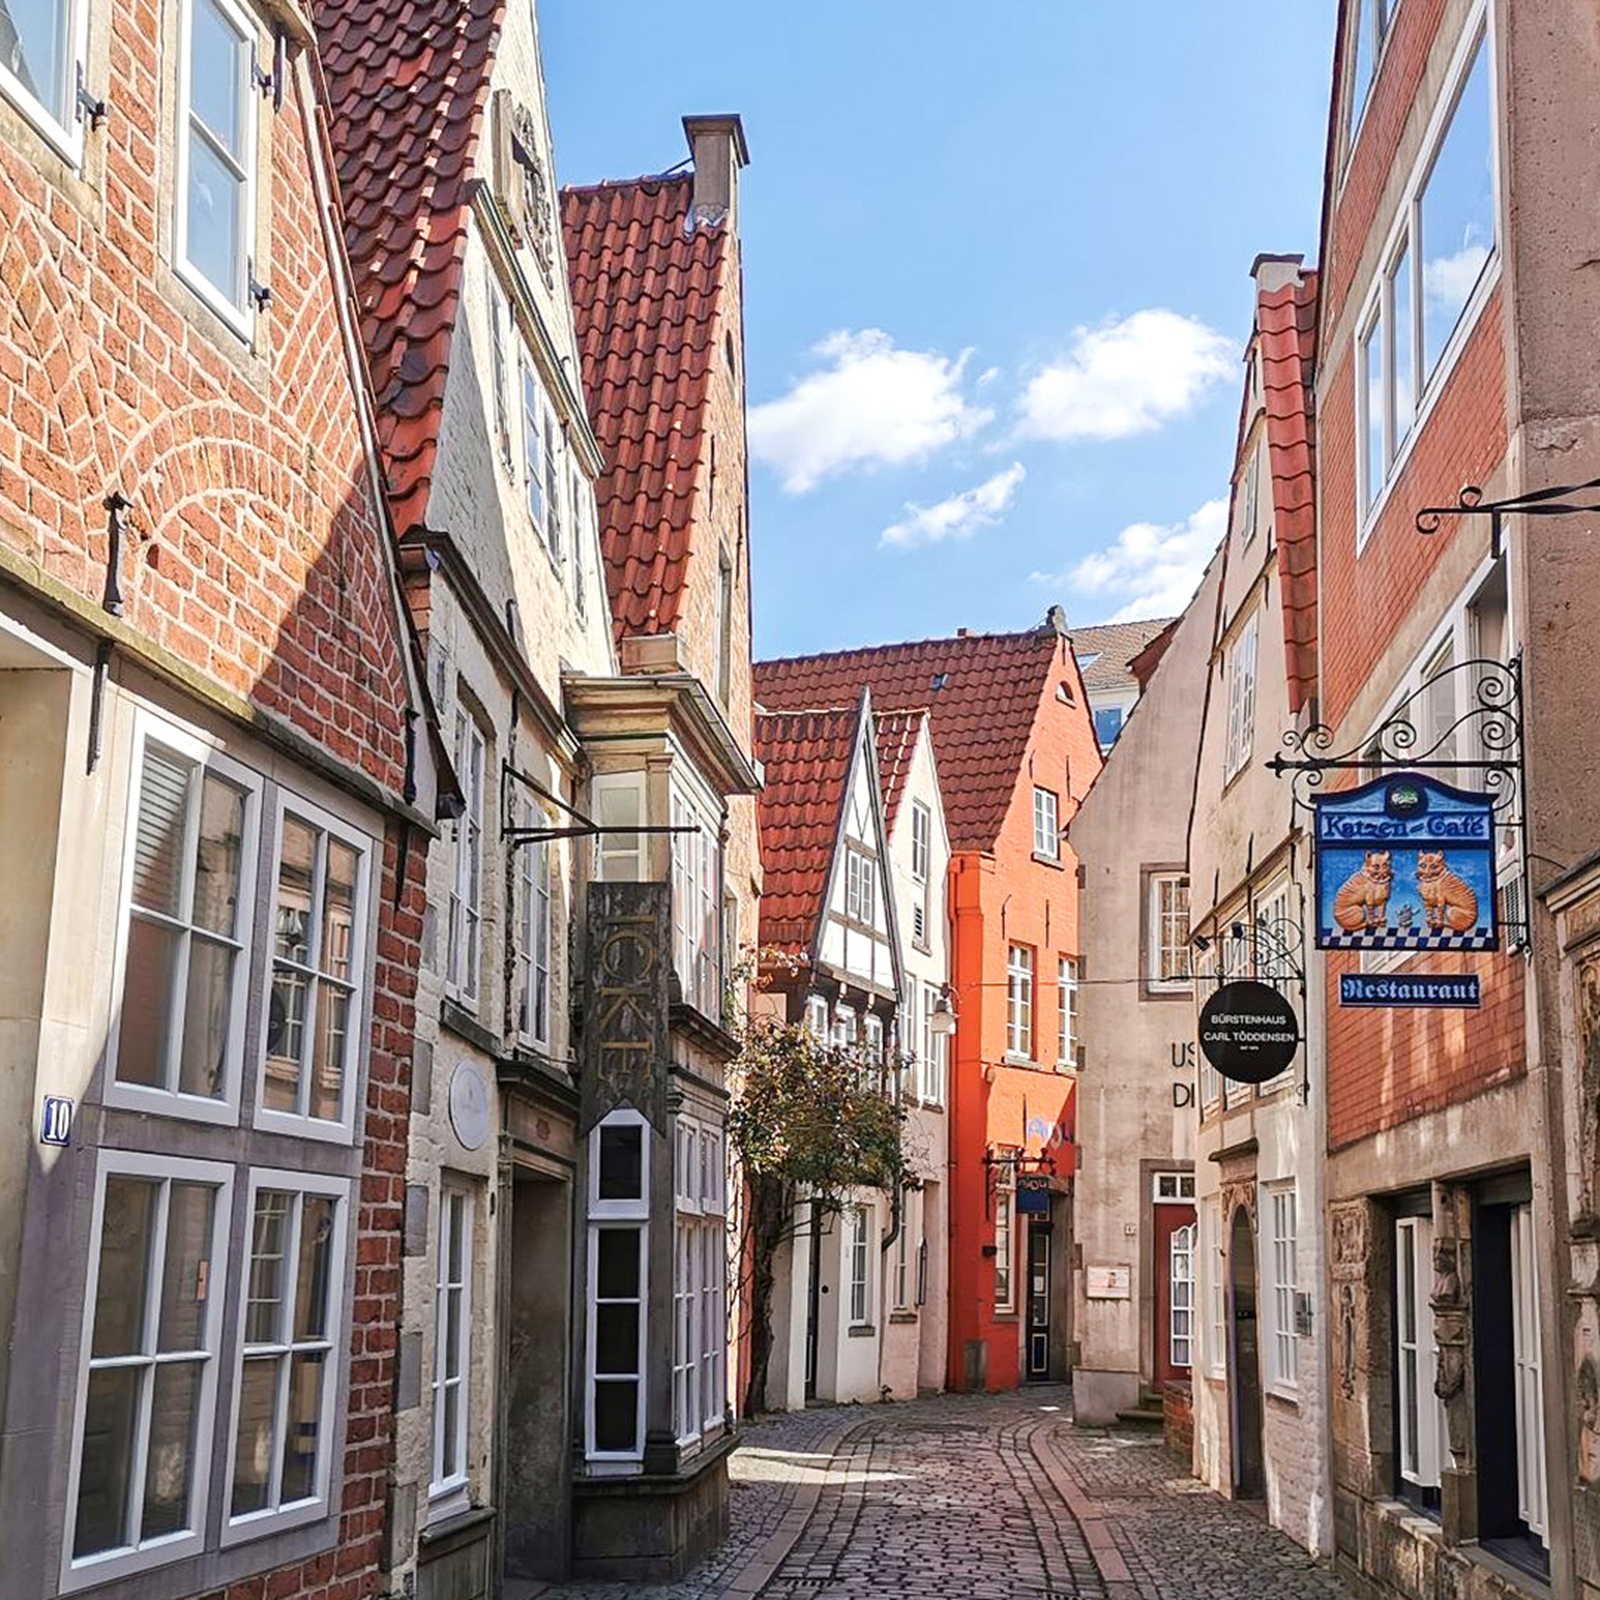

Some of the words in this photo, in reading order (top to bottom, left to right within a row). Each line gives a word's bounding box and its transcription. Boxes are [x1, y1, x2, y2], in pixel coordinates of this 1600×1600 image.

[1342, 979, 1478, 999] Restaurant
[1210, 1013, 1287, 1026] BÜRSTENHAUS
[1203, 1032, 1231, 1041] CARL
[1232, 1030, 1295, 1042] TÖDDENSEN
[46, 1100, 70, 1140] 10
